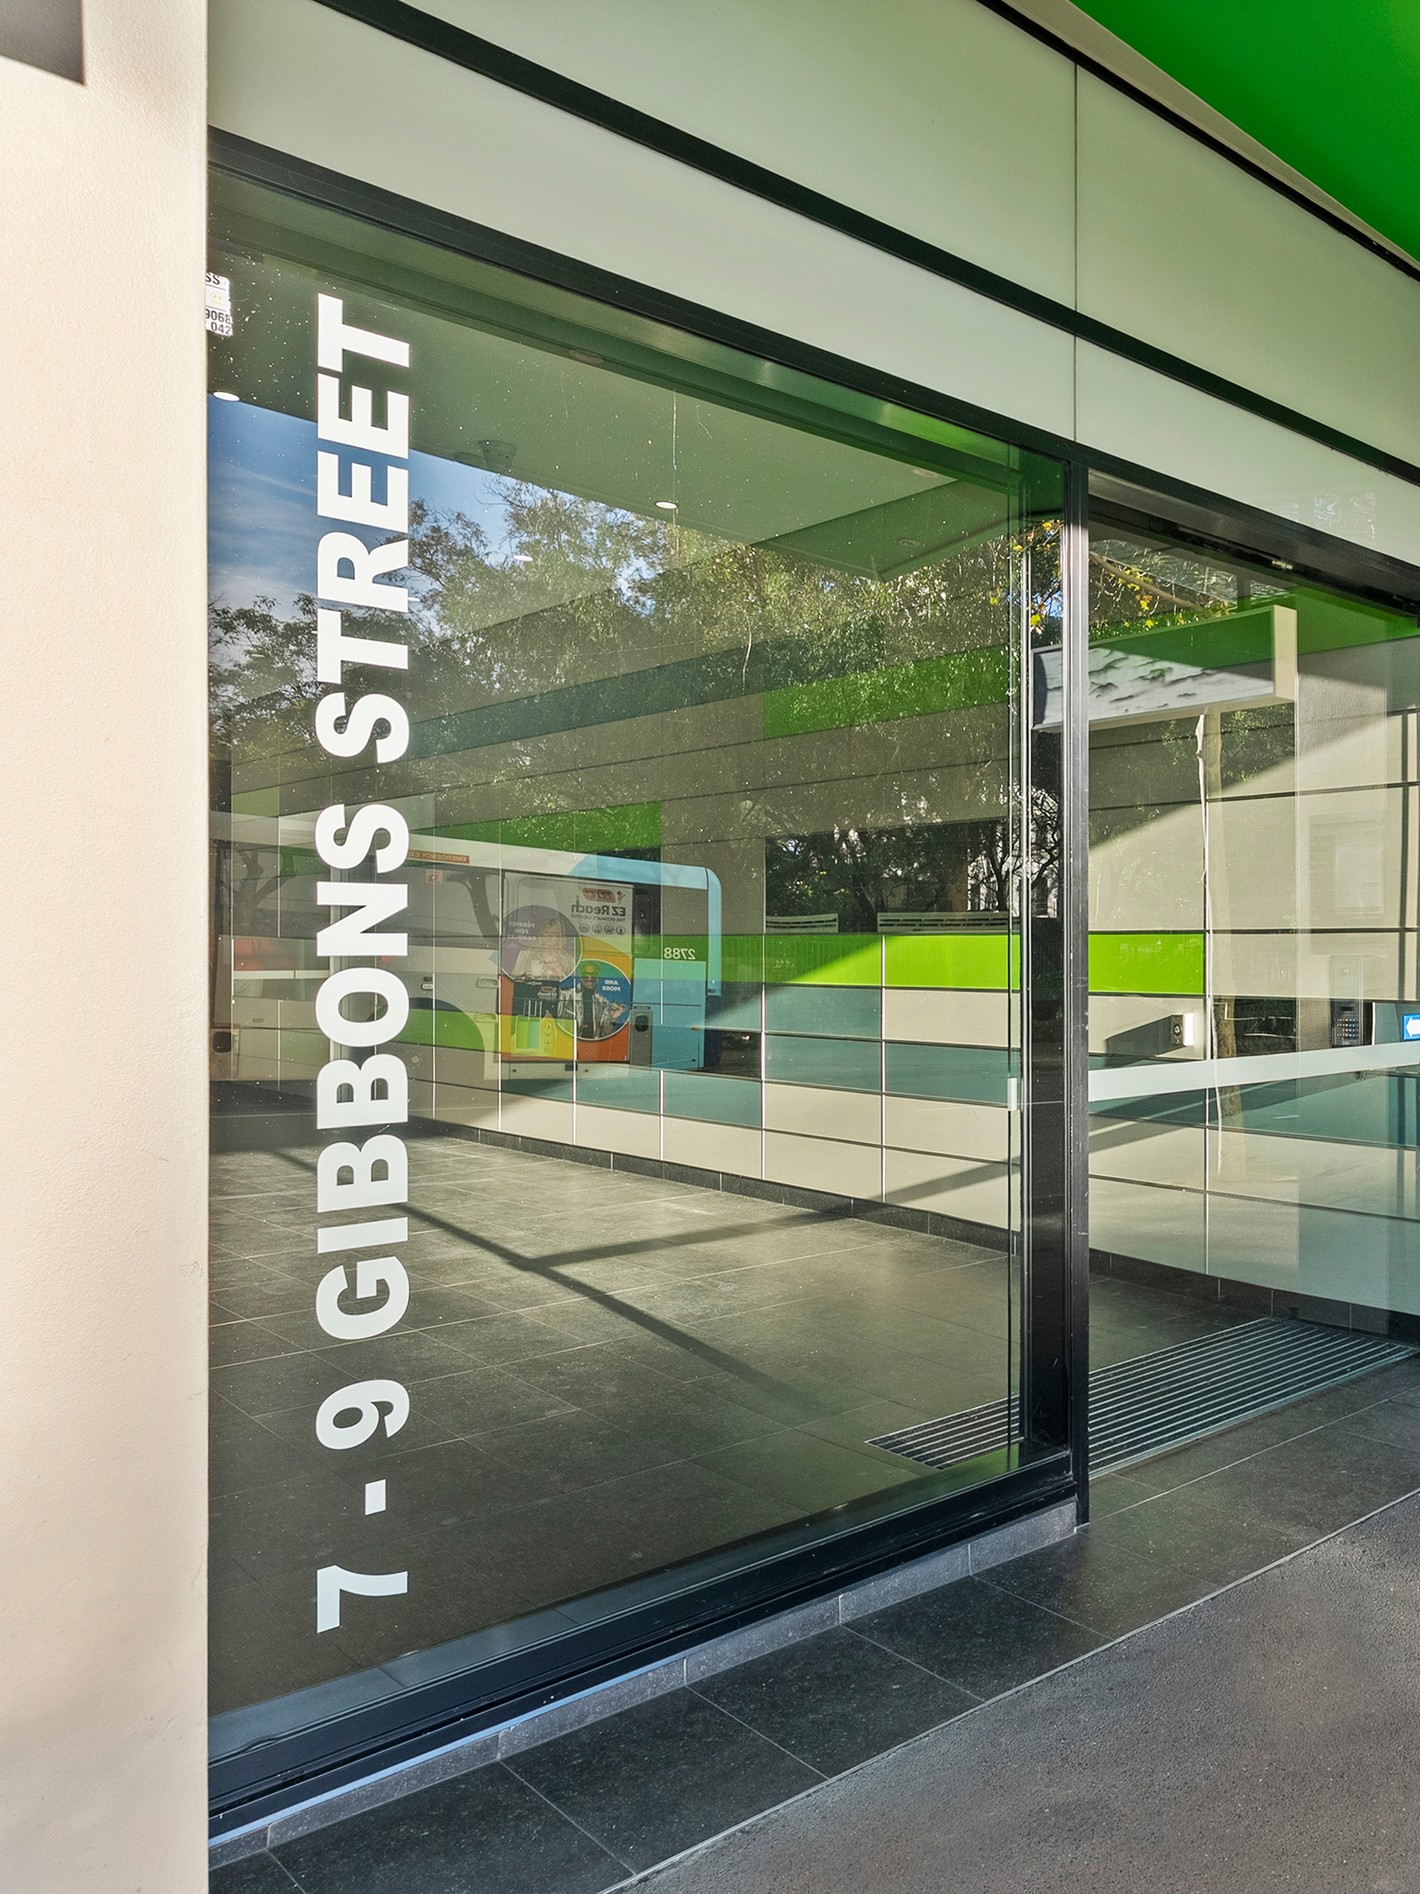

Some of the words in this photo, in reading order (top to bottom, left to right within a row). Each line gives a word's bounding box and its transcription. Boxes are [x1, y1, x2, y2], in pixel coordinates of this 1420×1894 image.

[315, 292, 410, 764] STREET
[315, 803, 409, 1340] GIBBONS
[316, 1379, 409, 1450] 9
[365, 1479, 387, 1515] -
[316, 1564, 408, 1633] 7
